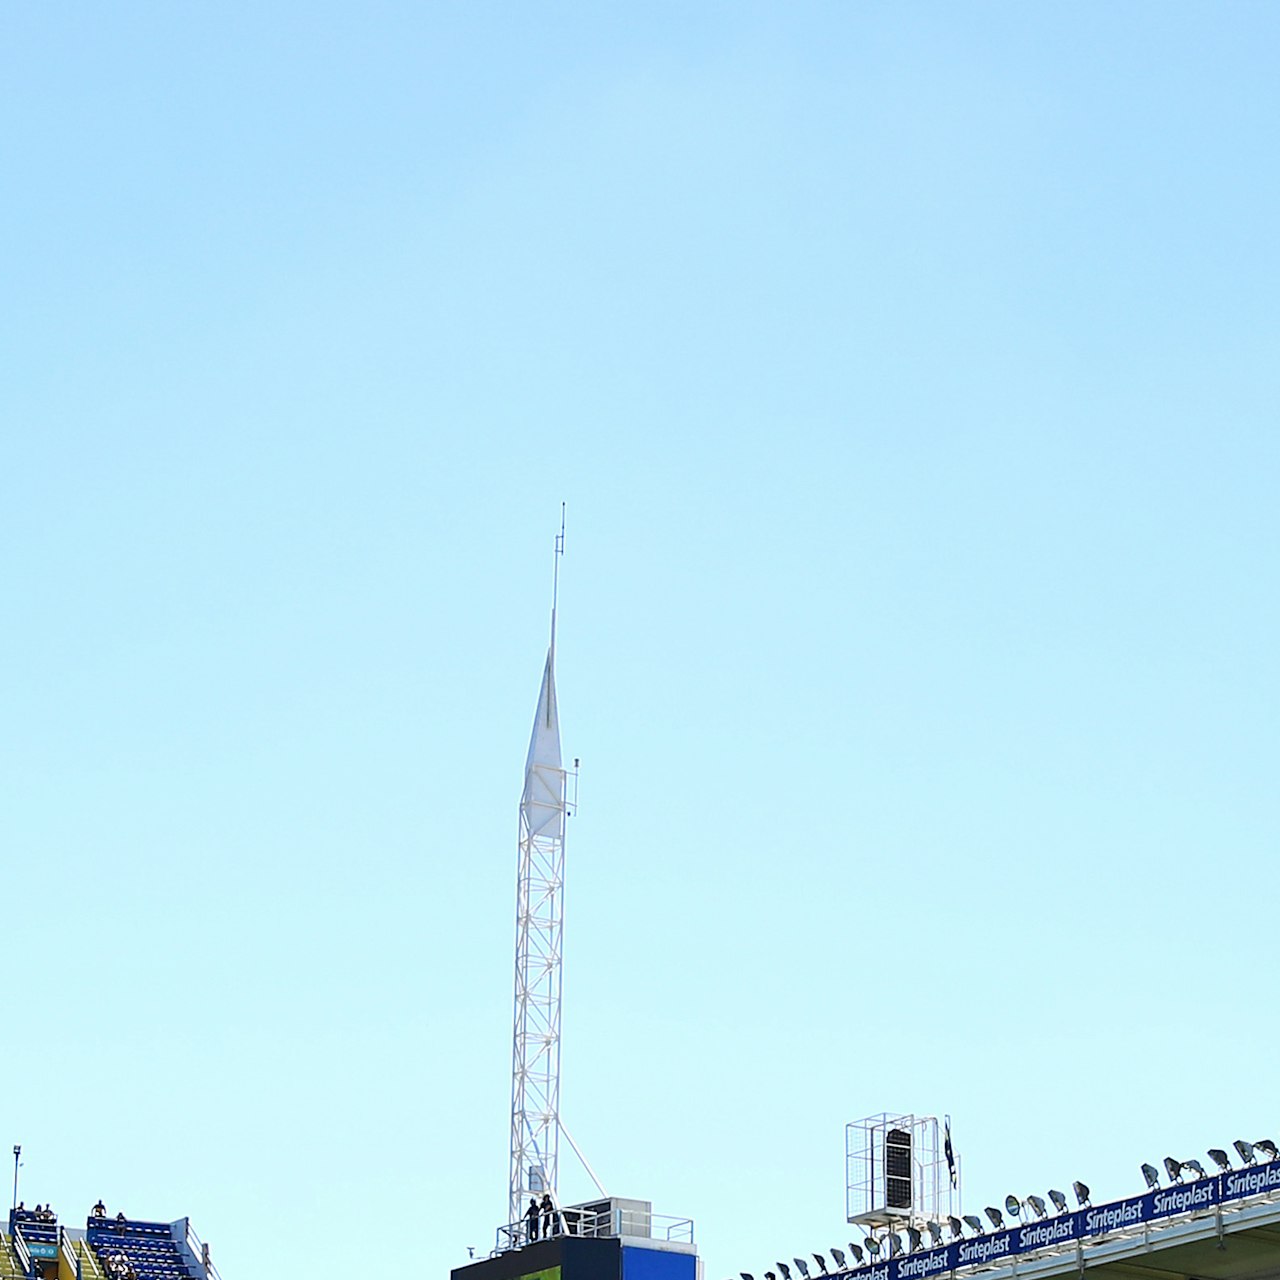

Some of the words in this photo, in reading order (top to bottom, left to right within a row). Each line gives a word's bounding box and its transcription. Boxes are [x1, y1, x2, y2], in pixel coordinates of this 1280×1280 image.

[1153, 1182, 1214, 1214] Sinteplast
[1086, 1201, 1142, 1231] Sinteplast
[1019, 1218, 1074, 1248] Sinteplast
[958, 1236, 1011, 1263] Sinteplast
[897, 1251, 948, 1279] Sinteplast
